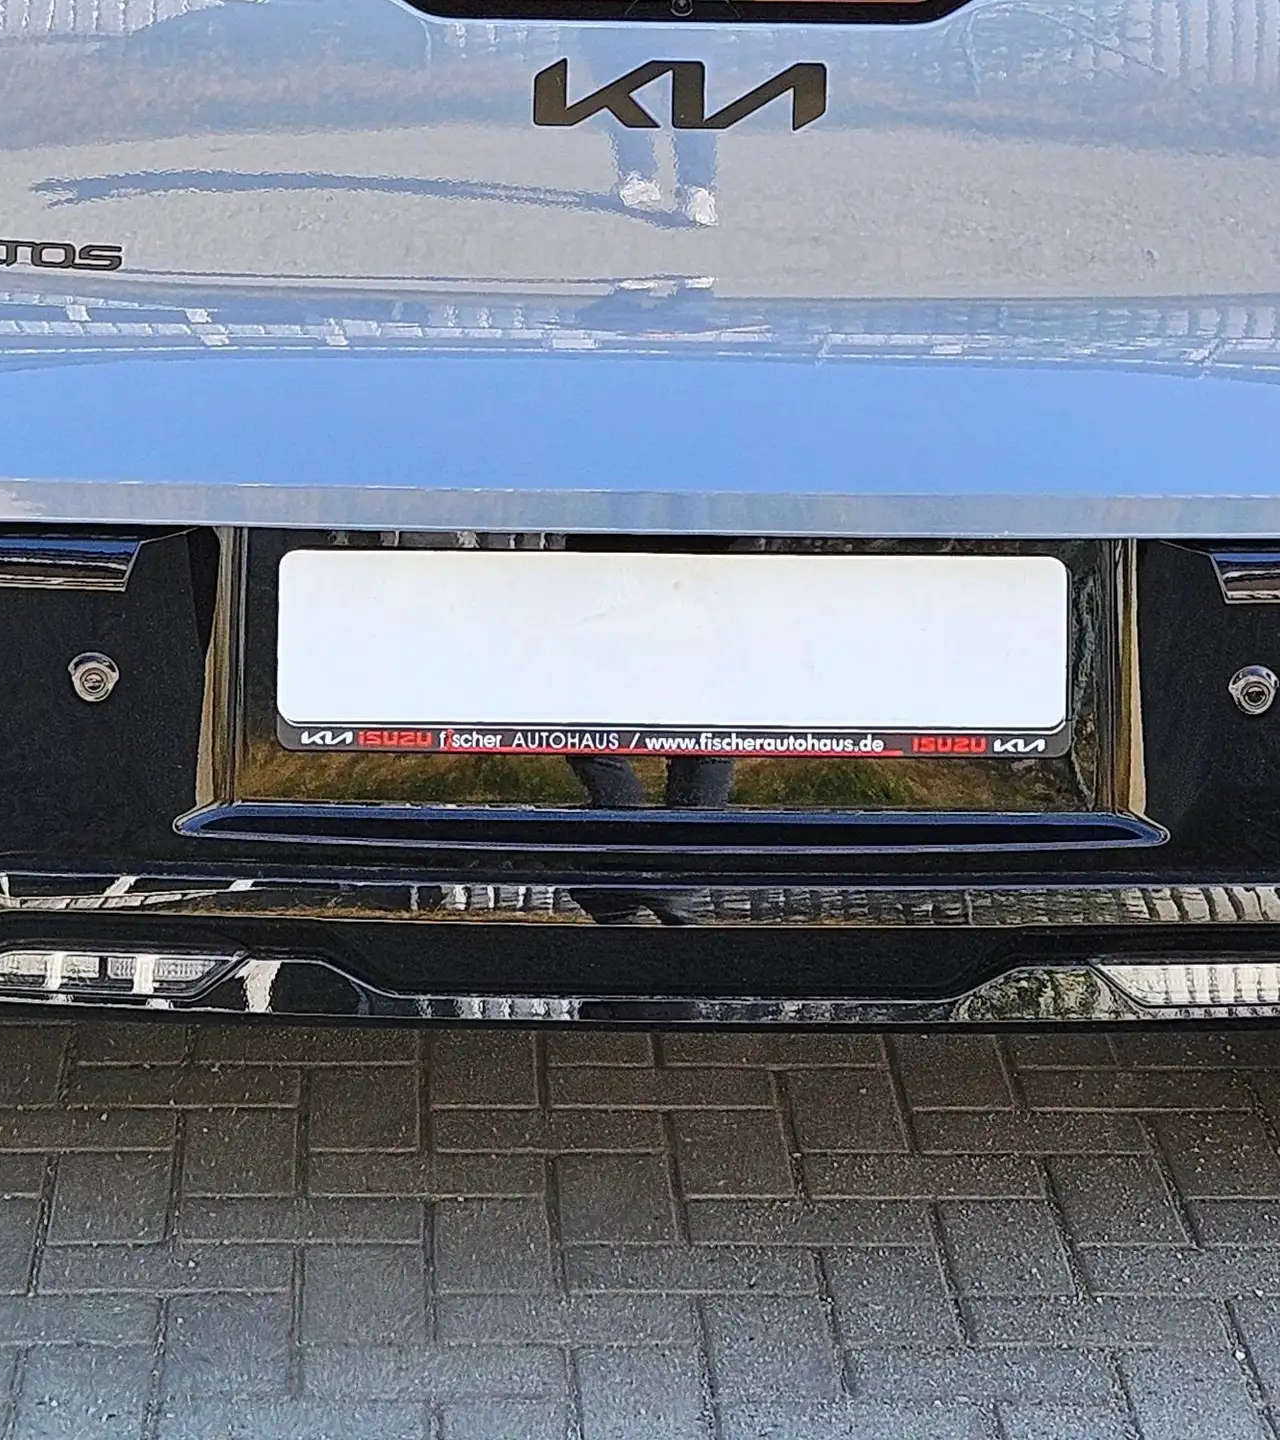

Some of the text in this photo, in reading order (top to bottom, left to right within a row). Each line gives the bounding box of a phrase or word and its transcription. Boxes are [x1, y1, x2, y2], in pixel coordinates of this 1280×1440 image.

[533, 58, 827, 131] KIA
[300, 730, 353, 746] KIA
[357, 730, 432, 746] ISUZU
[439, 728, 503, 750] fischer
[512, 732, 619, 750] AUTOHAUS
[645, 733, 885, 752] www.fischerautohaus.de
[911, 736, 988, 753] ISUZU
[993, 738, 1046, 753] KIA
